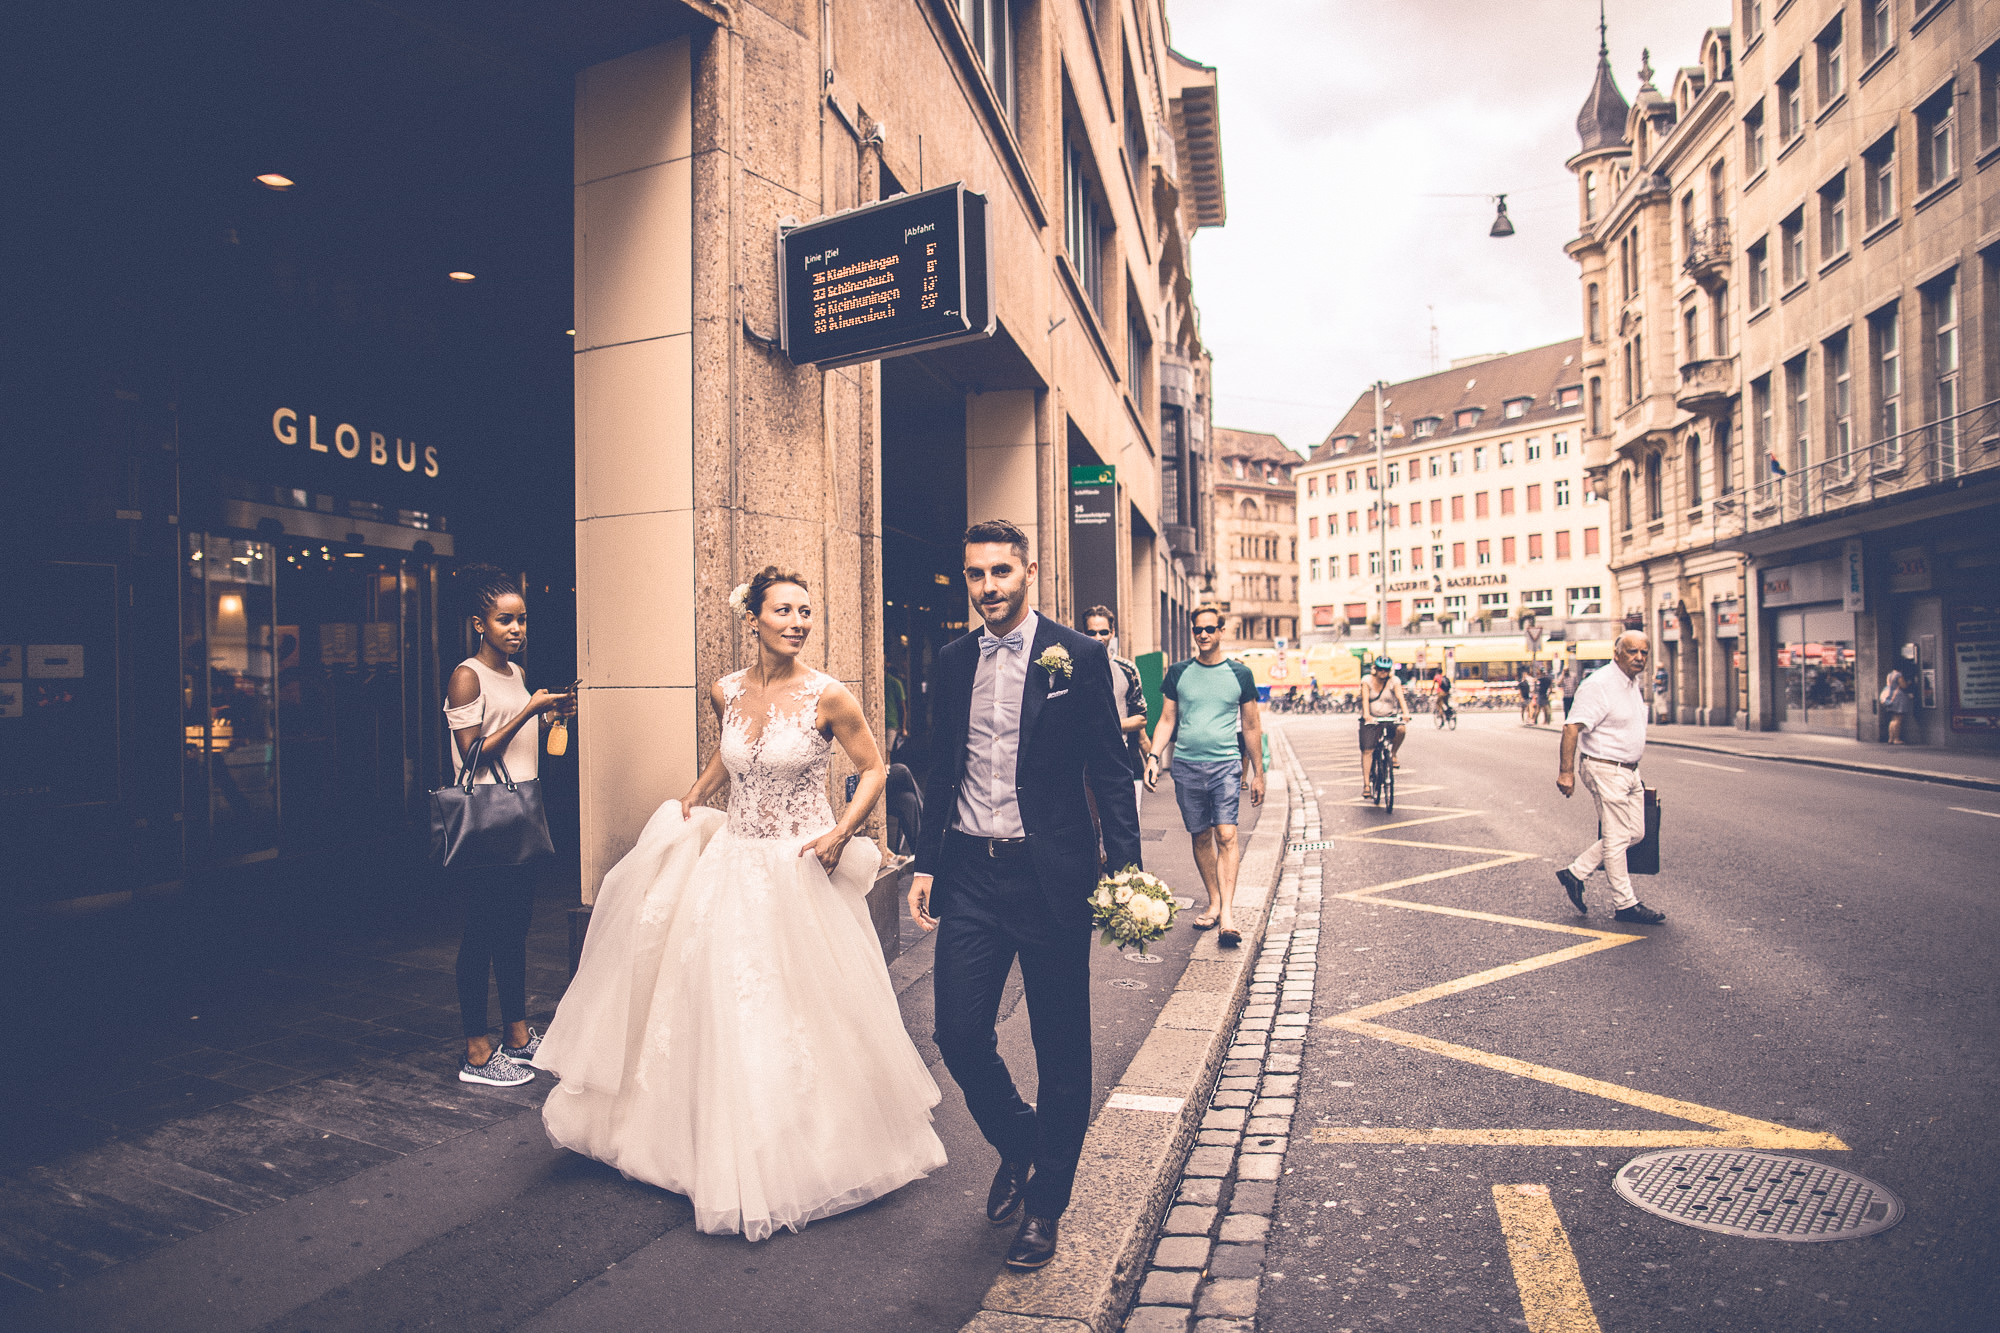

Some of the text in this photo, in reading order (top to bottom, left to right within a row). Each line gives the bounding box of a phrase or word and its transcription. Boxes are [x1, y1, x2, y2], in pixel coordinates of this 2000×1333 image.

[807, 222, 935, 264] Linie Ziel Abfahrt
[812, 271, 826, 285] 36
[272, 407, 439, 478] GLOBUS
[1375, 580, 1430, 593] BASSERIE
